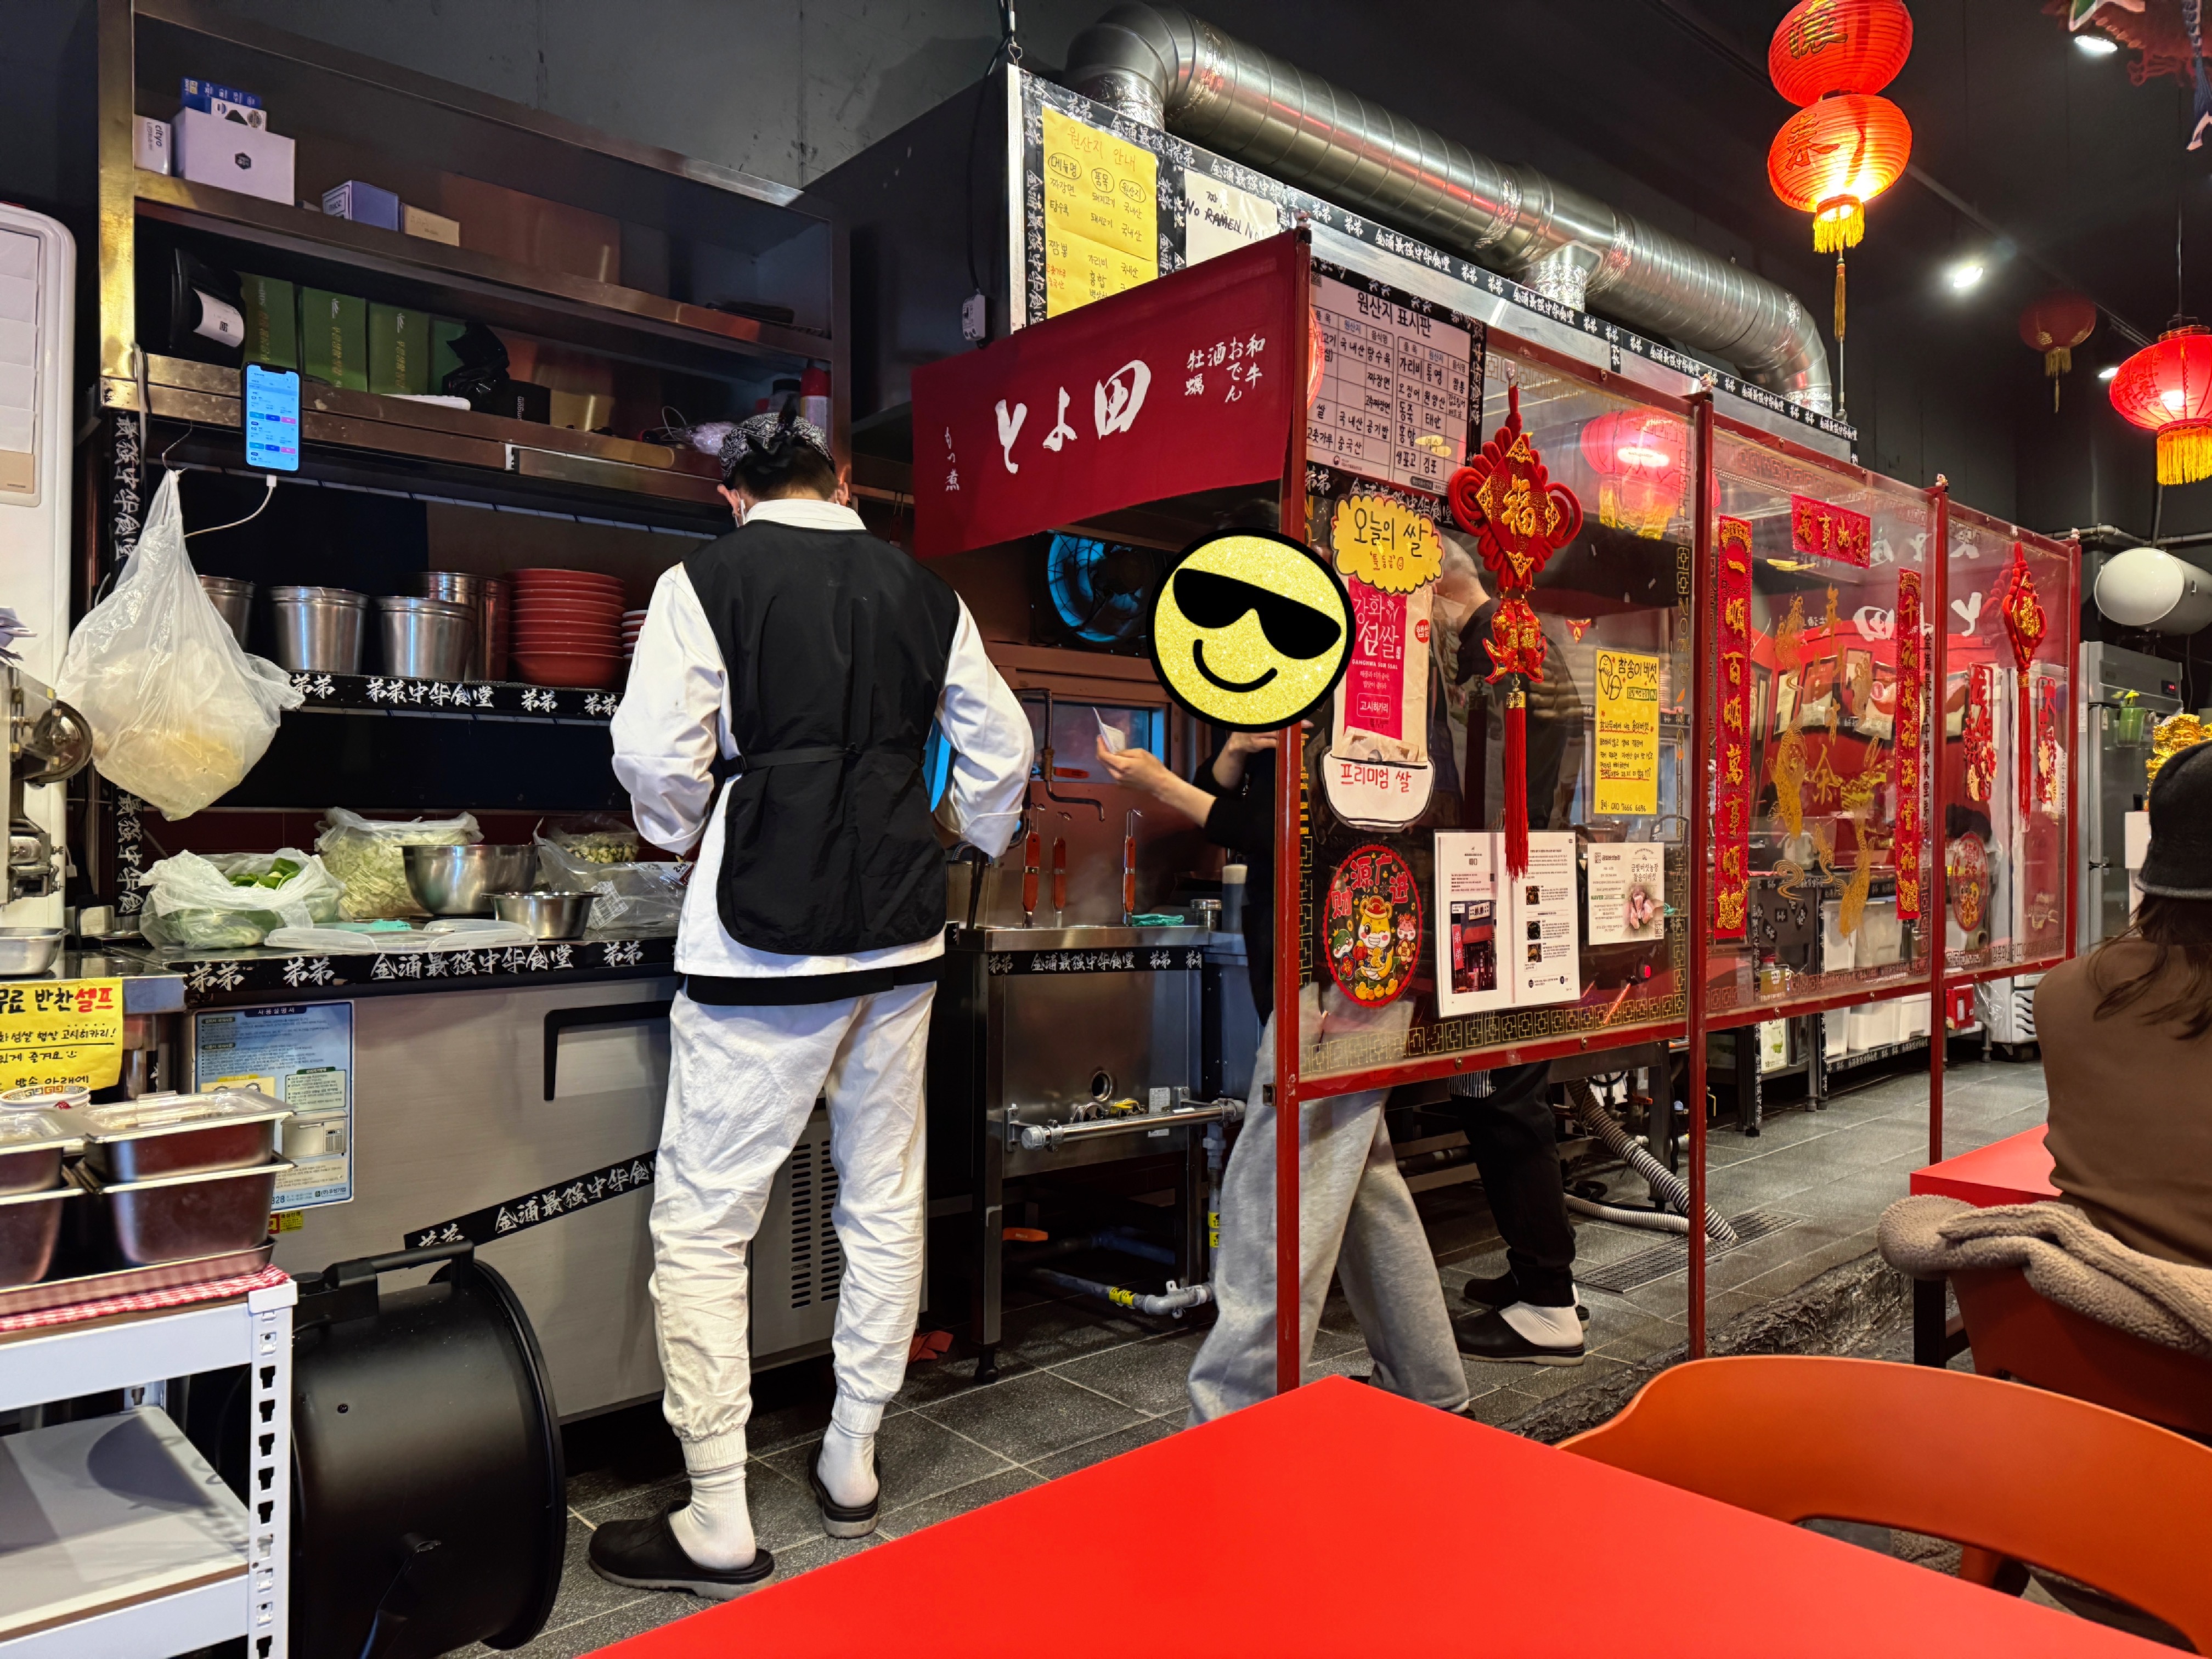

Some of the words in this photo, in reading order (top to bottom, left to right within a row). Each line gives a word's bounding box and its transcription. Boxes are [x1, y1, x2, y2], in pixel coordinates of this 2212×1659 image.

[1068, 126, 1103, 159] 원산지
[1114, 149, 1136, 171] 안내
[1050, 178, 1076, 197] 짜장면
[1124, 202, 1142, 219] 국내산
[1121, 223, 1142, 242] 국내산
[1205, 207, 1242, 235] RAMEN
[1121, 262, 1139, 278] 국내산
[1357, 291, 1393, 324] 원산지
[1397, 307, 1432, 339] 표시판
[1207, 341, 1227, 367] 酒
[1245, 334, 1266, 390] 和牛
[1367, 346, 1391, 368] 탕수육
[1224, 337, 1244, 403] おでん
[1400, 356, 1424, 380] 가리비
[1367, 371, 1391, 390] 짜장면
[1398, 382, 1420, 401] 오징어
[1317, 403, 1326, 419] 쌀
[1424, 456, 1437, 474] 김포
[1354, 507, 1395, 550] 오늘의
[1403, 522, 1429, 558] 쌀
[1353, 594, 1386, 624] 강화
[1358, 620, 1400, 659] 섬쌀
[1359, 701, 1389, 713] 고시히카리
[1340, 763, 1389, 789] 프리미엄
[1395, 770, 1412, 793] 쌀
[189, 961, 245, 994] 弟弟
[283, 957, 335, 988] 弟弟
[371, 944, 574, 980] 金浦最强中华食堂
[603, 940, 644, 967] 弟弟
[1031, 951, 1135, 972] 金浦最强中华食堂
[257, 1007, 295, 1015] 사용설명서
[28, 1051, 63, 1063] 즐겨요
[44, 1075, 89, 1085] 아래에
